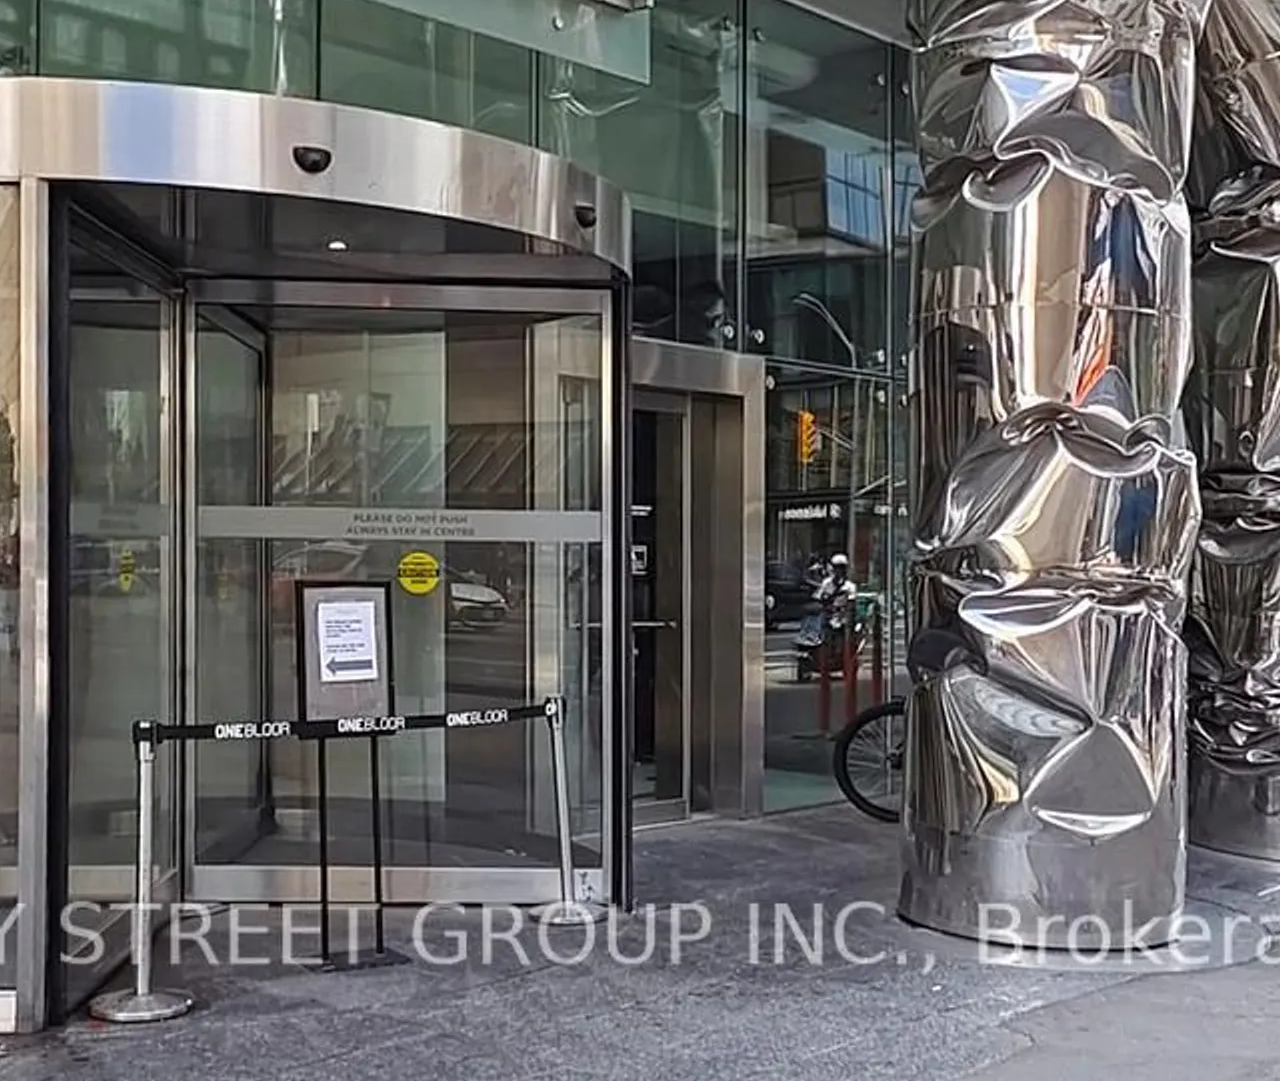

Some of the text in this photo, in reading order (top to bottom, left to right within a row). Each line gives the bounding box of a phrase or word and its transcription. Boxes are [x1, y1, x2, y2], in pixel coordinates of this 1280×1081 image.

[353, 512, 468, 524] PLEASE DO NOT PUSH
[347, 526, 389, 535] ALWAYS
[391, 526, 417, 536] STAY
[420, 527, 432, 536] IN
[338, 716, 406, 732] ONEBLOOR
[447, 709, 508, 727] ONEBLOOR
[215, 722, 290, 739] ONEBLOOR
